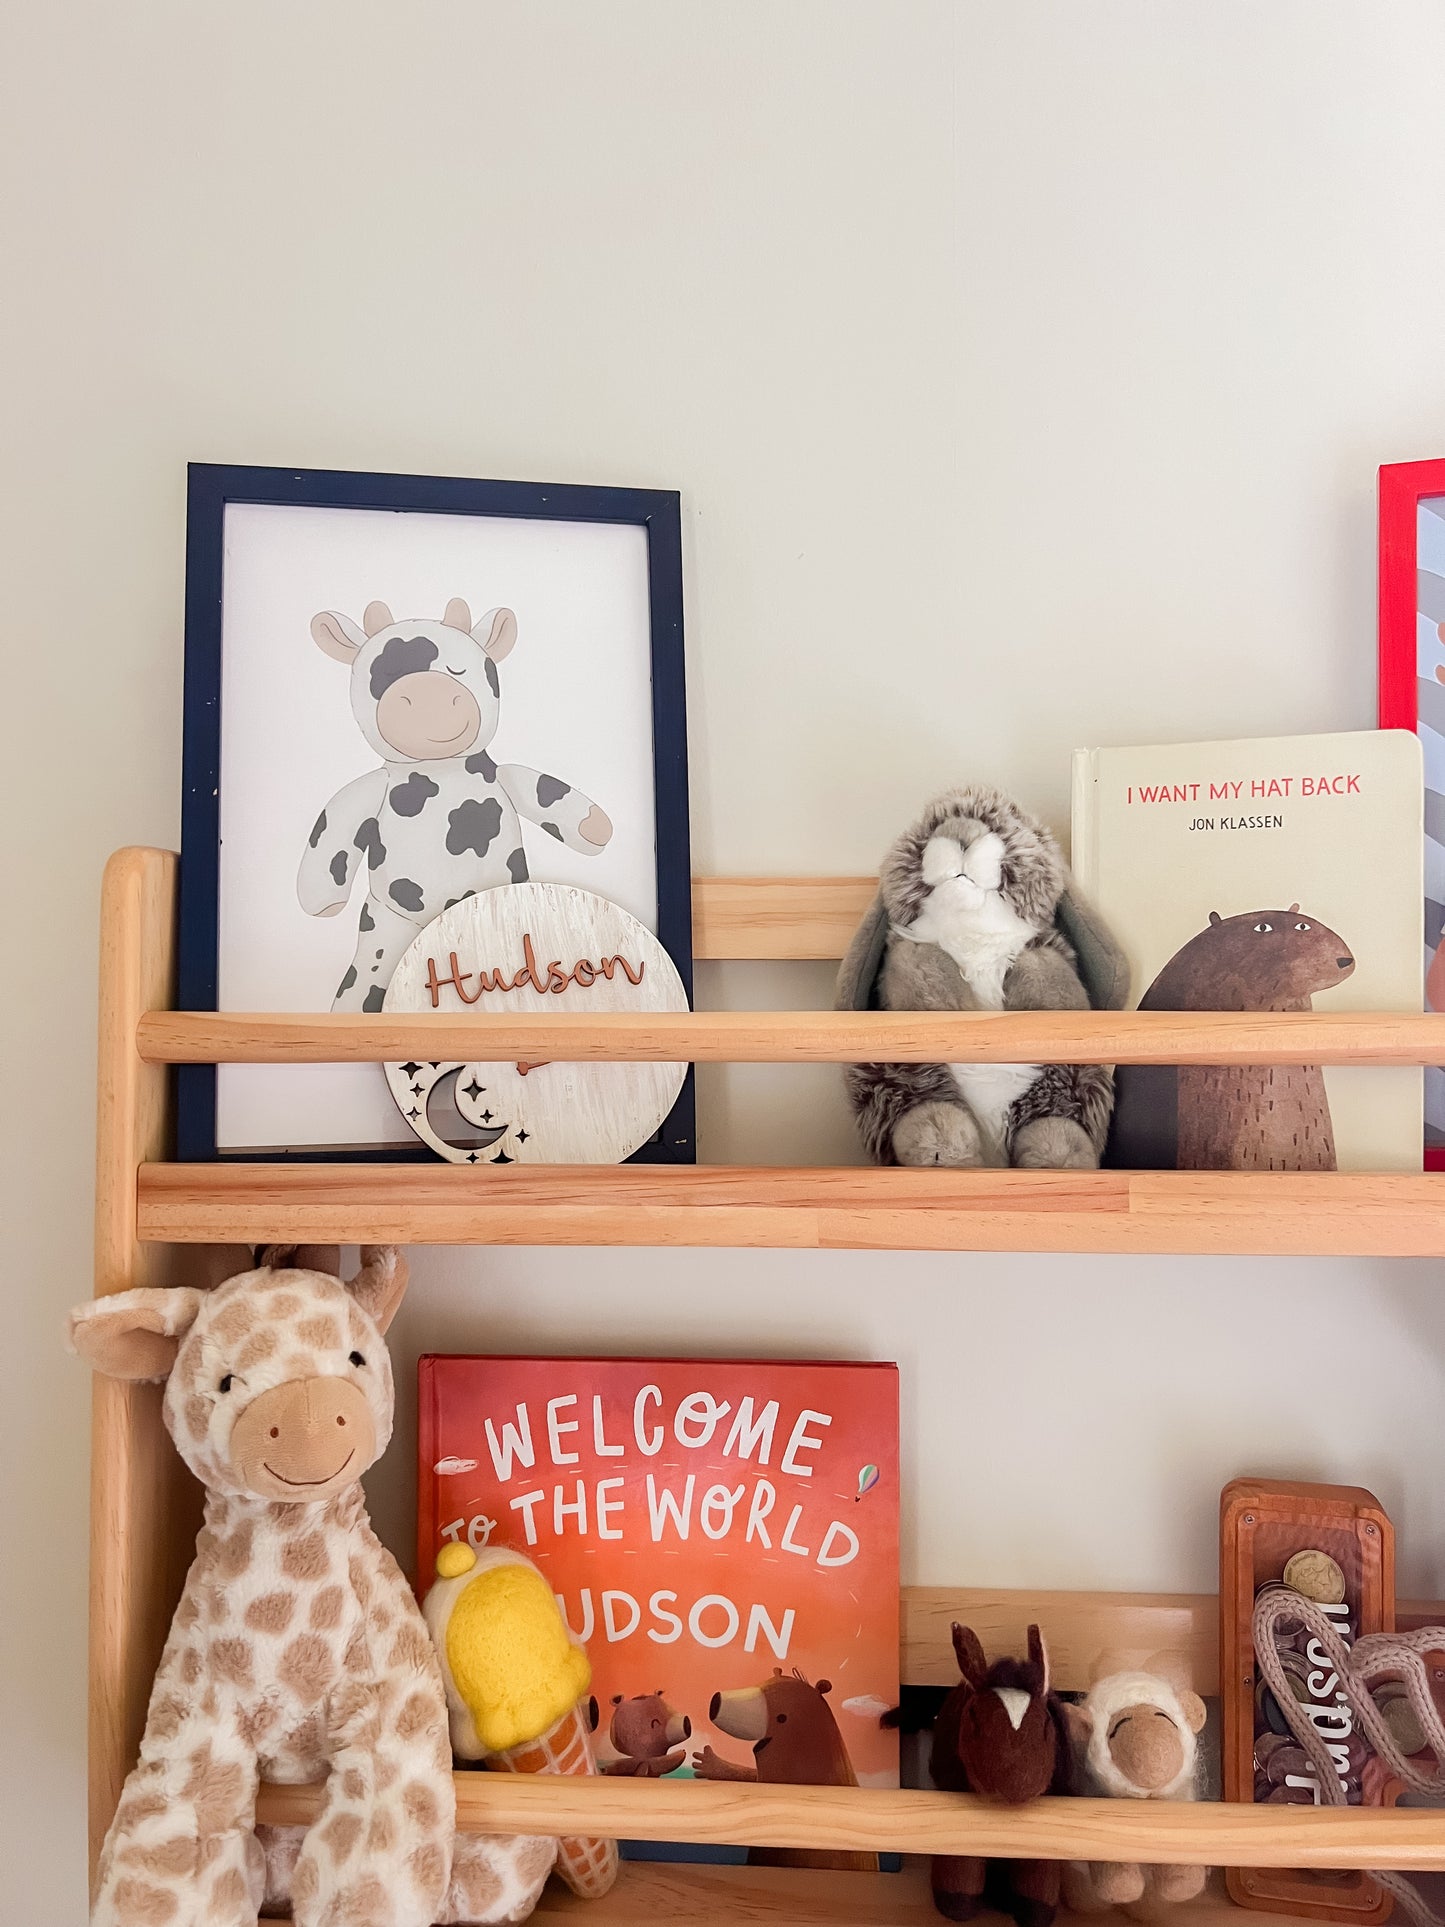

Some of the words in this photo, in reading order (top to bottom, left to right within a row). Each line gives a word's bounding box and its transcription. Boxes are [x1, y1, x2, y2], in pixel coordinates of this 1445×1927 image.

[1127, 787, 1133, 805] I
[1138, 783, 1201, 804] WANT
[1209, 781, 1244, 801] MY
[1250, 777, 1294, 799] HAT
[1301, 774, 1361, 797] BACK
[1188, 817, 1215, 832] JON
[1220, 815, 1283, 831] KLASSEN
[424, 933, 645, 1009] Hudson
[483, 1384, 833, 1483] WELCOME
[440, 1514, 498, 1549] TO
[509, 1476, 626, 1546] THE
[645, 1472, 861, 1568] WORLD
[555, 1587, 797, 1661] UDSON
